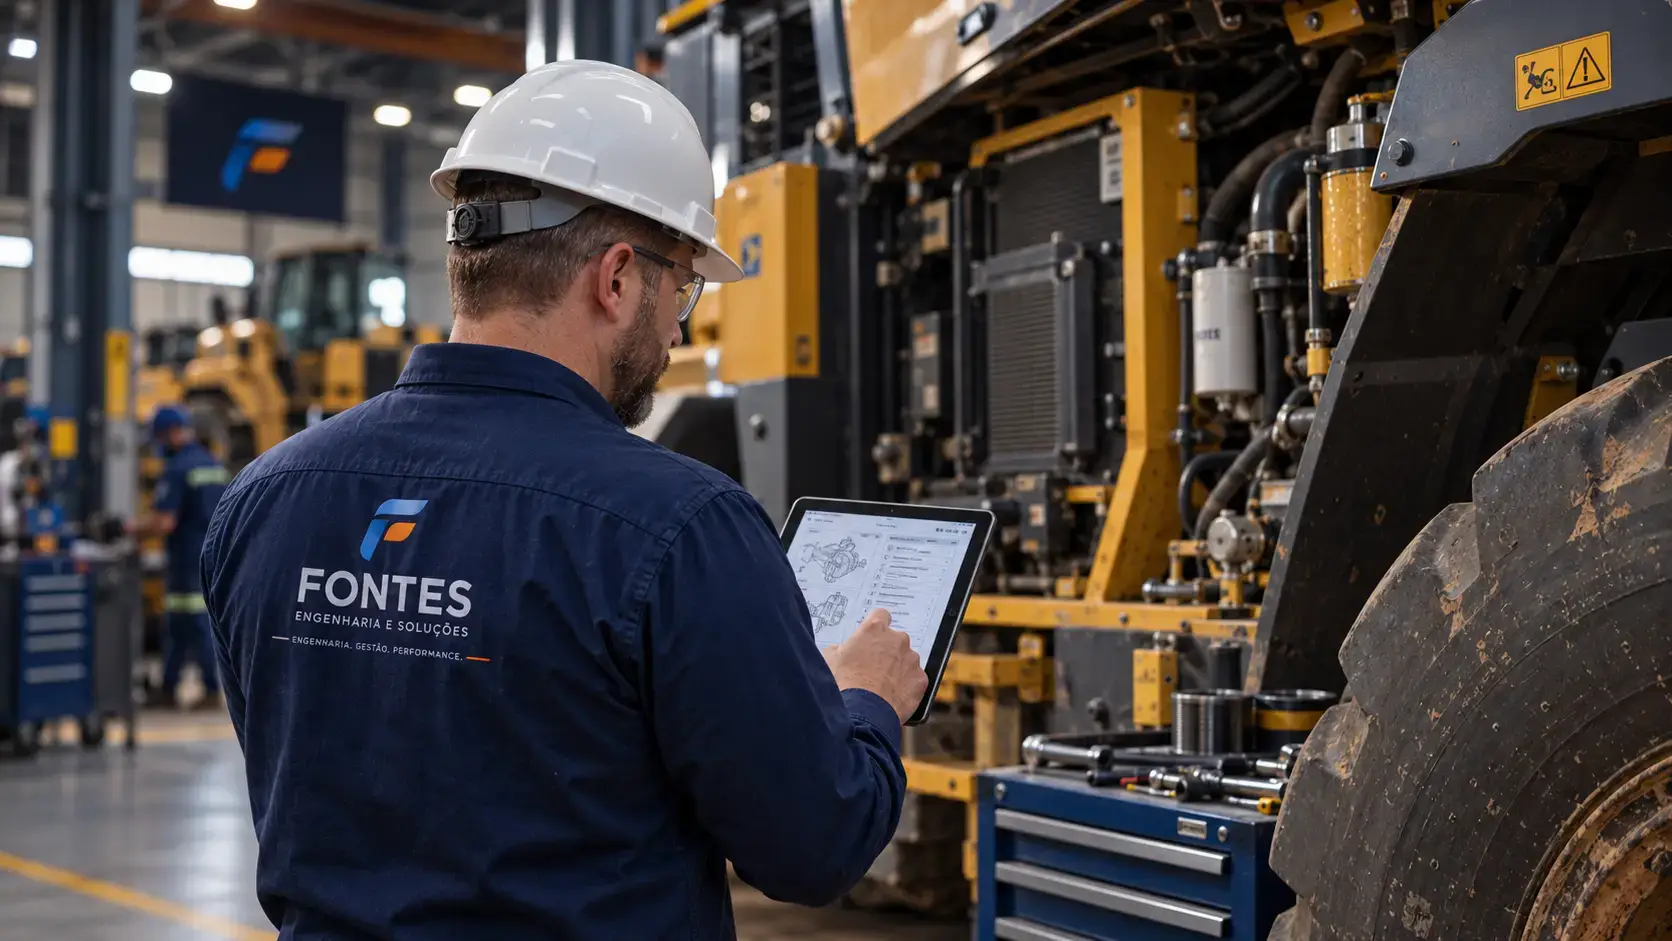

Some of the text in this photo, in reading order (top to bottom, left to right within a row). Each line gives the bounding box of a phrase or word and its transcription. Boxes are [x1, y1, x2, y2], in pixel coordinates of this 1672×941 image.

[297, 567, 472, 618] FONTES
[295, 611, 469, 638] ENGENHARIA E SOLUÇÕES
[292, 636, 463, 661] ENGENHARIA. GESTÃO. PERFORMANCE.
